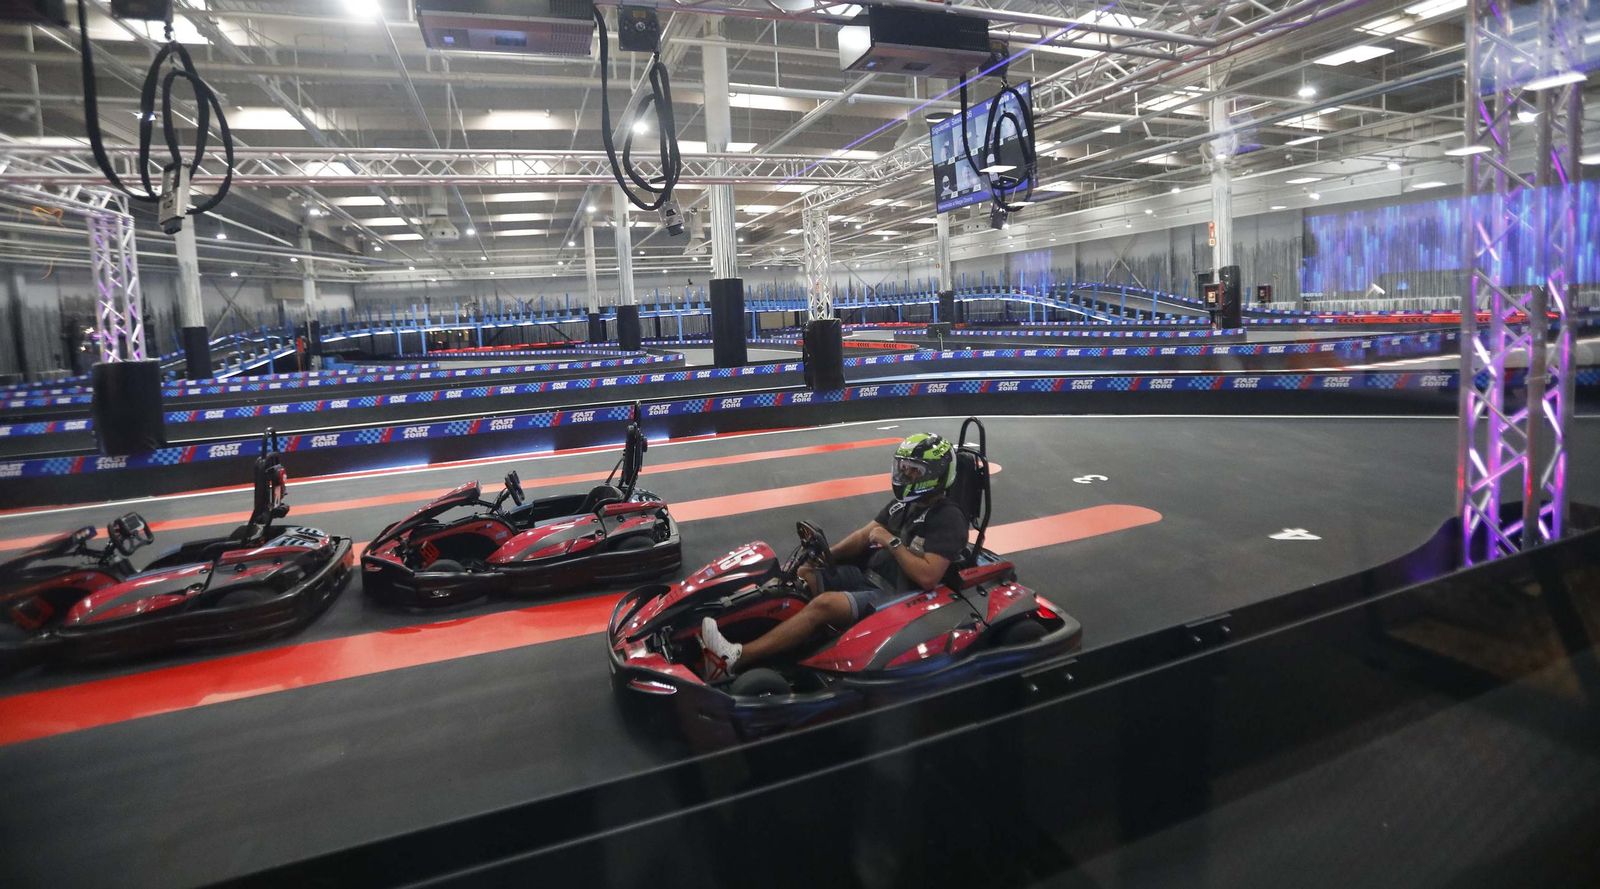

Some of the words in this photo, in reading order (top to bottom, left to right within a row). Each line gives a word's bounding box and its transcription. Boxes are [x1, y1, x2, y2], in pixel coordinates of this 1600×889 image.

[572, 411, 596, 419] FAST
[490, 418, 516, 426] FAST
[403, 425, 431, 434] FAST
[311, 434, 340, 443] FAST
[208, 443, 242, 452] FAST
[96, 456, 128, 464] FAST
[0, 463, 25, 472] AST
[1072, 474, 1109, 484] 3
[1267, 528, 1322, 540] 4
